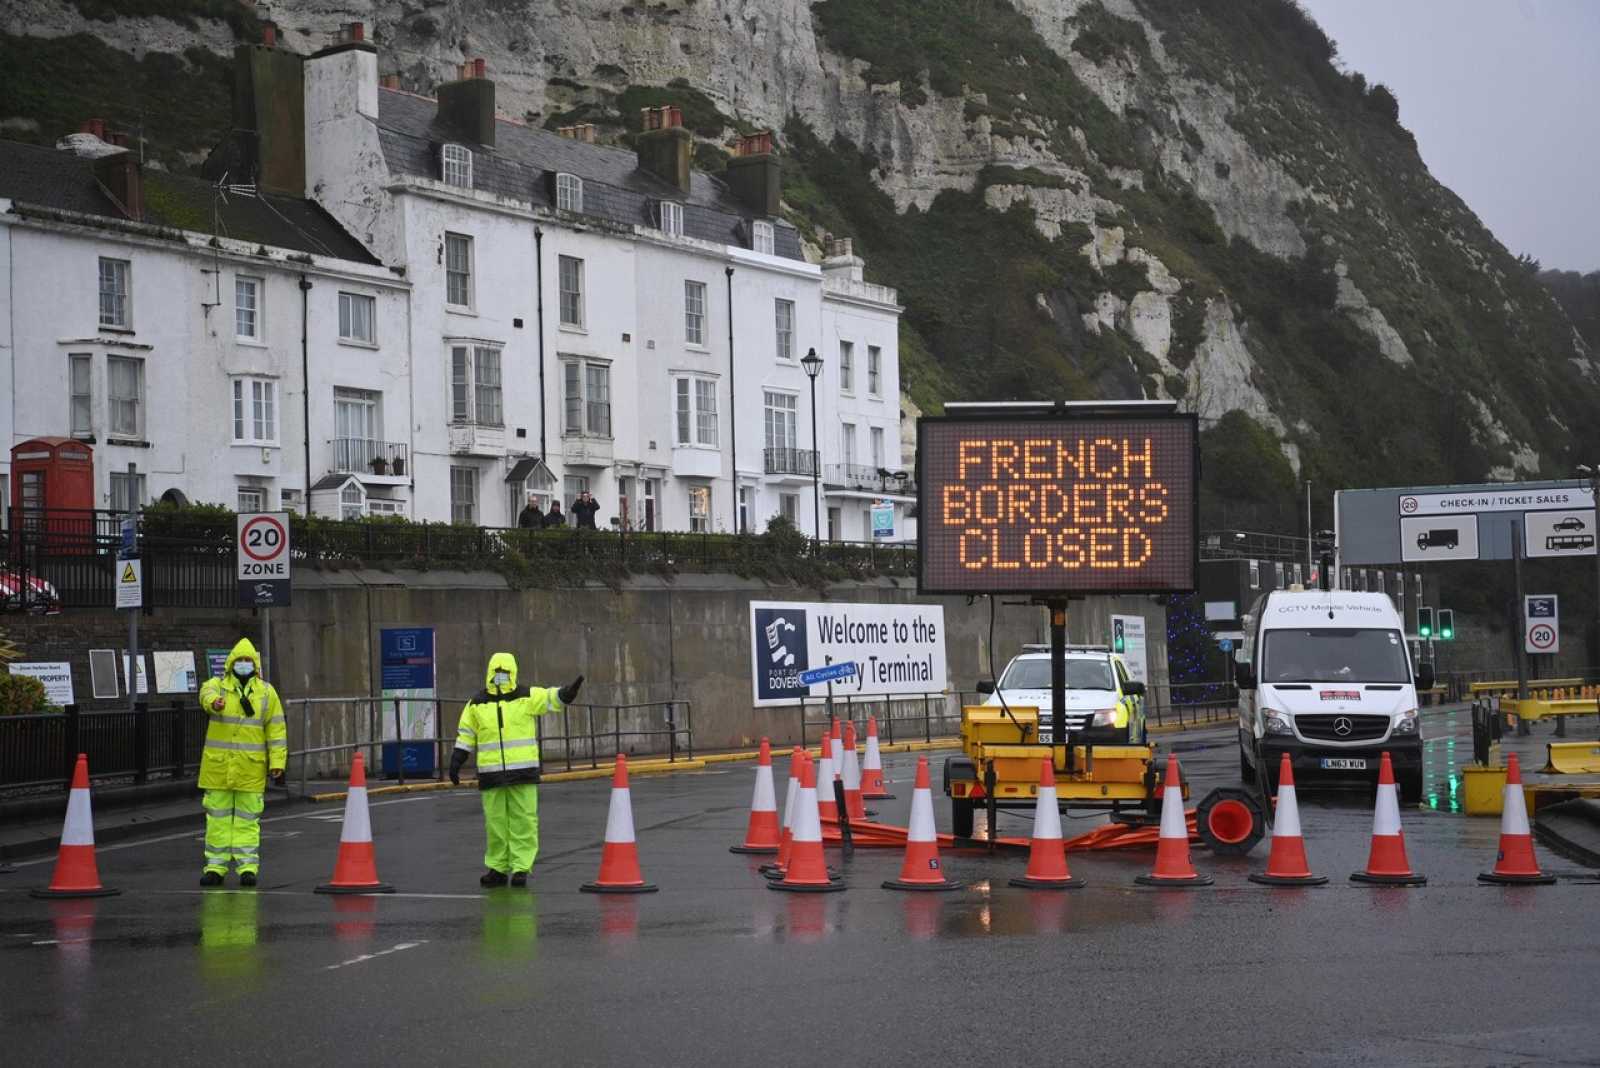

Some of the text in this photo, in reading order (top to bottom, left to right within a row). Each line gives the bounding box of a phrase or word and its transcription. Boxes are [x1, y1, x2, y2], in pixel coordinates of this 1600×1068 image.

[959, 437, 1152, 480] FRENCH
[943, 483, 1169, 525] BORDERS
[1403, 501, 1416, 510] 20
[1440, 497, 1489, 509] CHECK-IN
[1498, 495, 1533, 506] TICKET
[1535, 494, 1570, 505] SALES
[248, 527, 280, 548] 20
[959, 527, 1152, 569] CLOSED
[242, 562, 285, 576] ZONE
[1278, 605, 1309, 614] CCTV
[1346, 604, 1383, 614] Vehicle
[817, 613, 936, 645] Welcome to the
[1535, 630, 1551, 642] 20
[769, 669, 786, 677] PORT
[869, 653, 933, 684] Terminal
[39, 674, 70, 683] PROPERTY
[769, 677, 798, 690] DOVER
